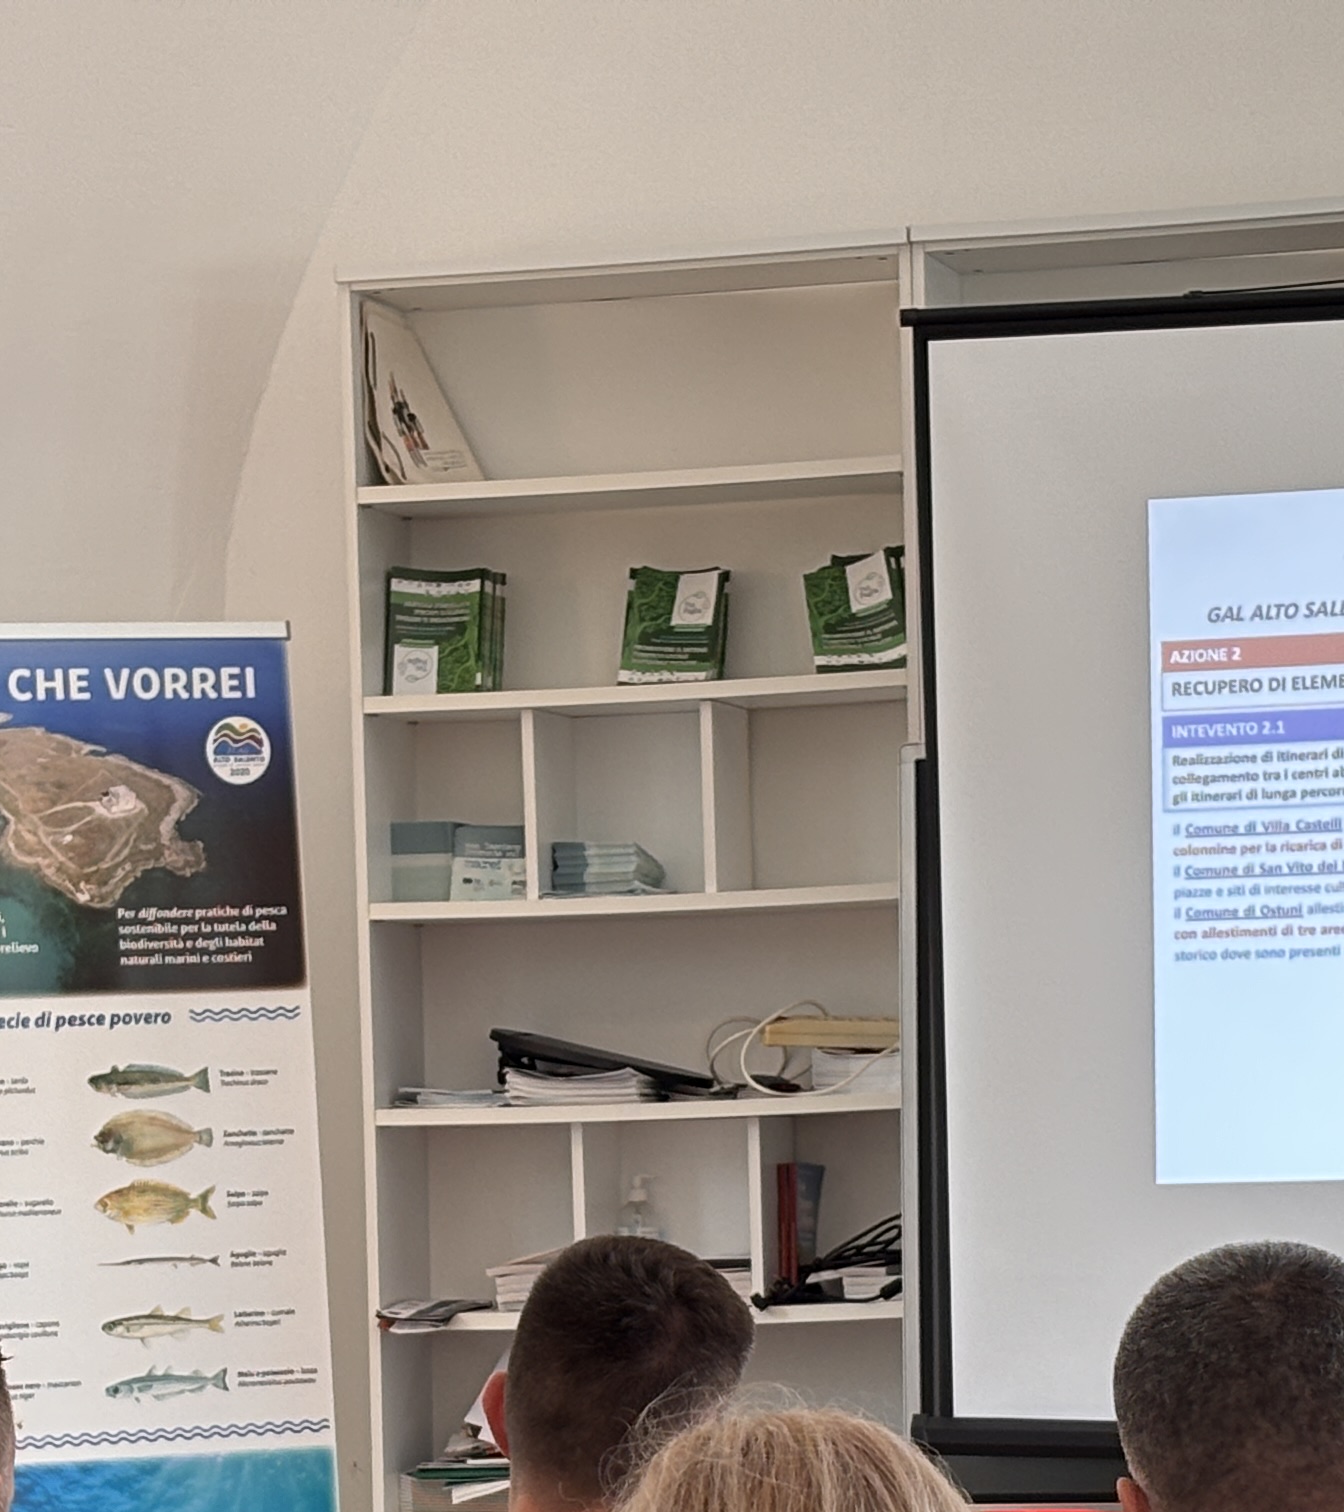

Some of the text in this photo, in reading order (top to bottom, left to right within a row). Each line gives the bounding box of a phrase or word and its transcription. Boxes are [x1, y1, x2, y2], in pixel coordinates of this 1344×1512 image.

[1206, 605, 1244, 623] GAL
[1250, 602, 1299, 621] ALTO
[1170, 647, 1227, 664] AZIONE
[8, 667, 91, 702] CHE
[104, 666, 256, 701] VORREI
[1170, 677, 1262, 697] RECUPERO
[1268, 676, 1286, 692] DI
[1170, 720, 1286, 738] INTEVENTO 2.1
[1172, 747, 1344, 766] Realizzazione di itinerari di
[1172, 771, 1259, 786] collegamento
[1262, 770, 1280, 781] tra
[1291, 766, 1328, 780] centri
[1190, 789, 1242, 802] itinerari
[1245, 788, 1258, 801] di
[1261, 787, 1296, 801] lunga
[118, 904, 288, 921] Per diffondere pratiche di pesca
[180, 924, 198, 936] per
[200, 921, 211, 932] la
[213, 921, 246, 932] tutela
[248, 919, 276, 931] della
[195, 936, 222, 951] degli
[224, 935, 264, 947] habitat
[120, 953, 162, 965] naturali
[164, 952, 200, 964] marini
[210, 951, 252, 963] costieri
[34, 1011, 51, 1028] di
[54, 1013, 105, 1032] pesce
[109, 1011, 172, 1030] povero
